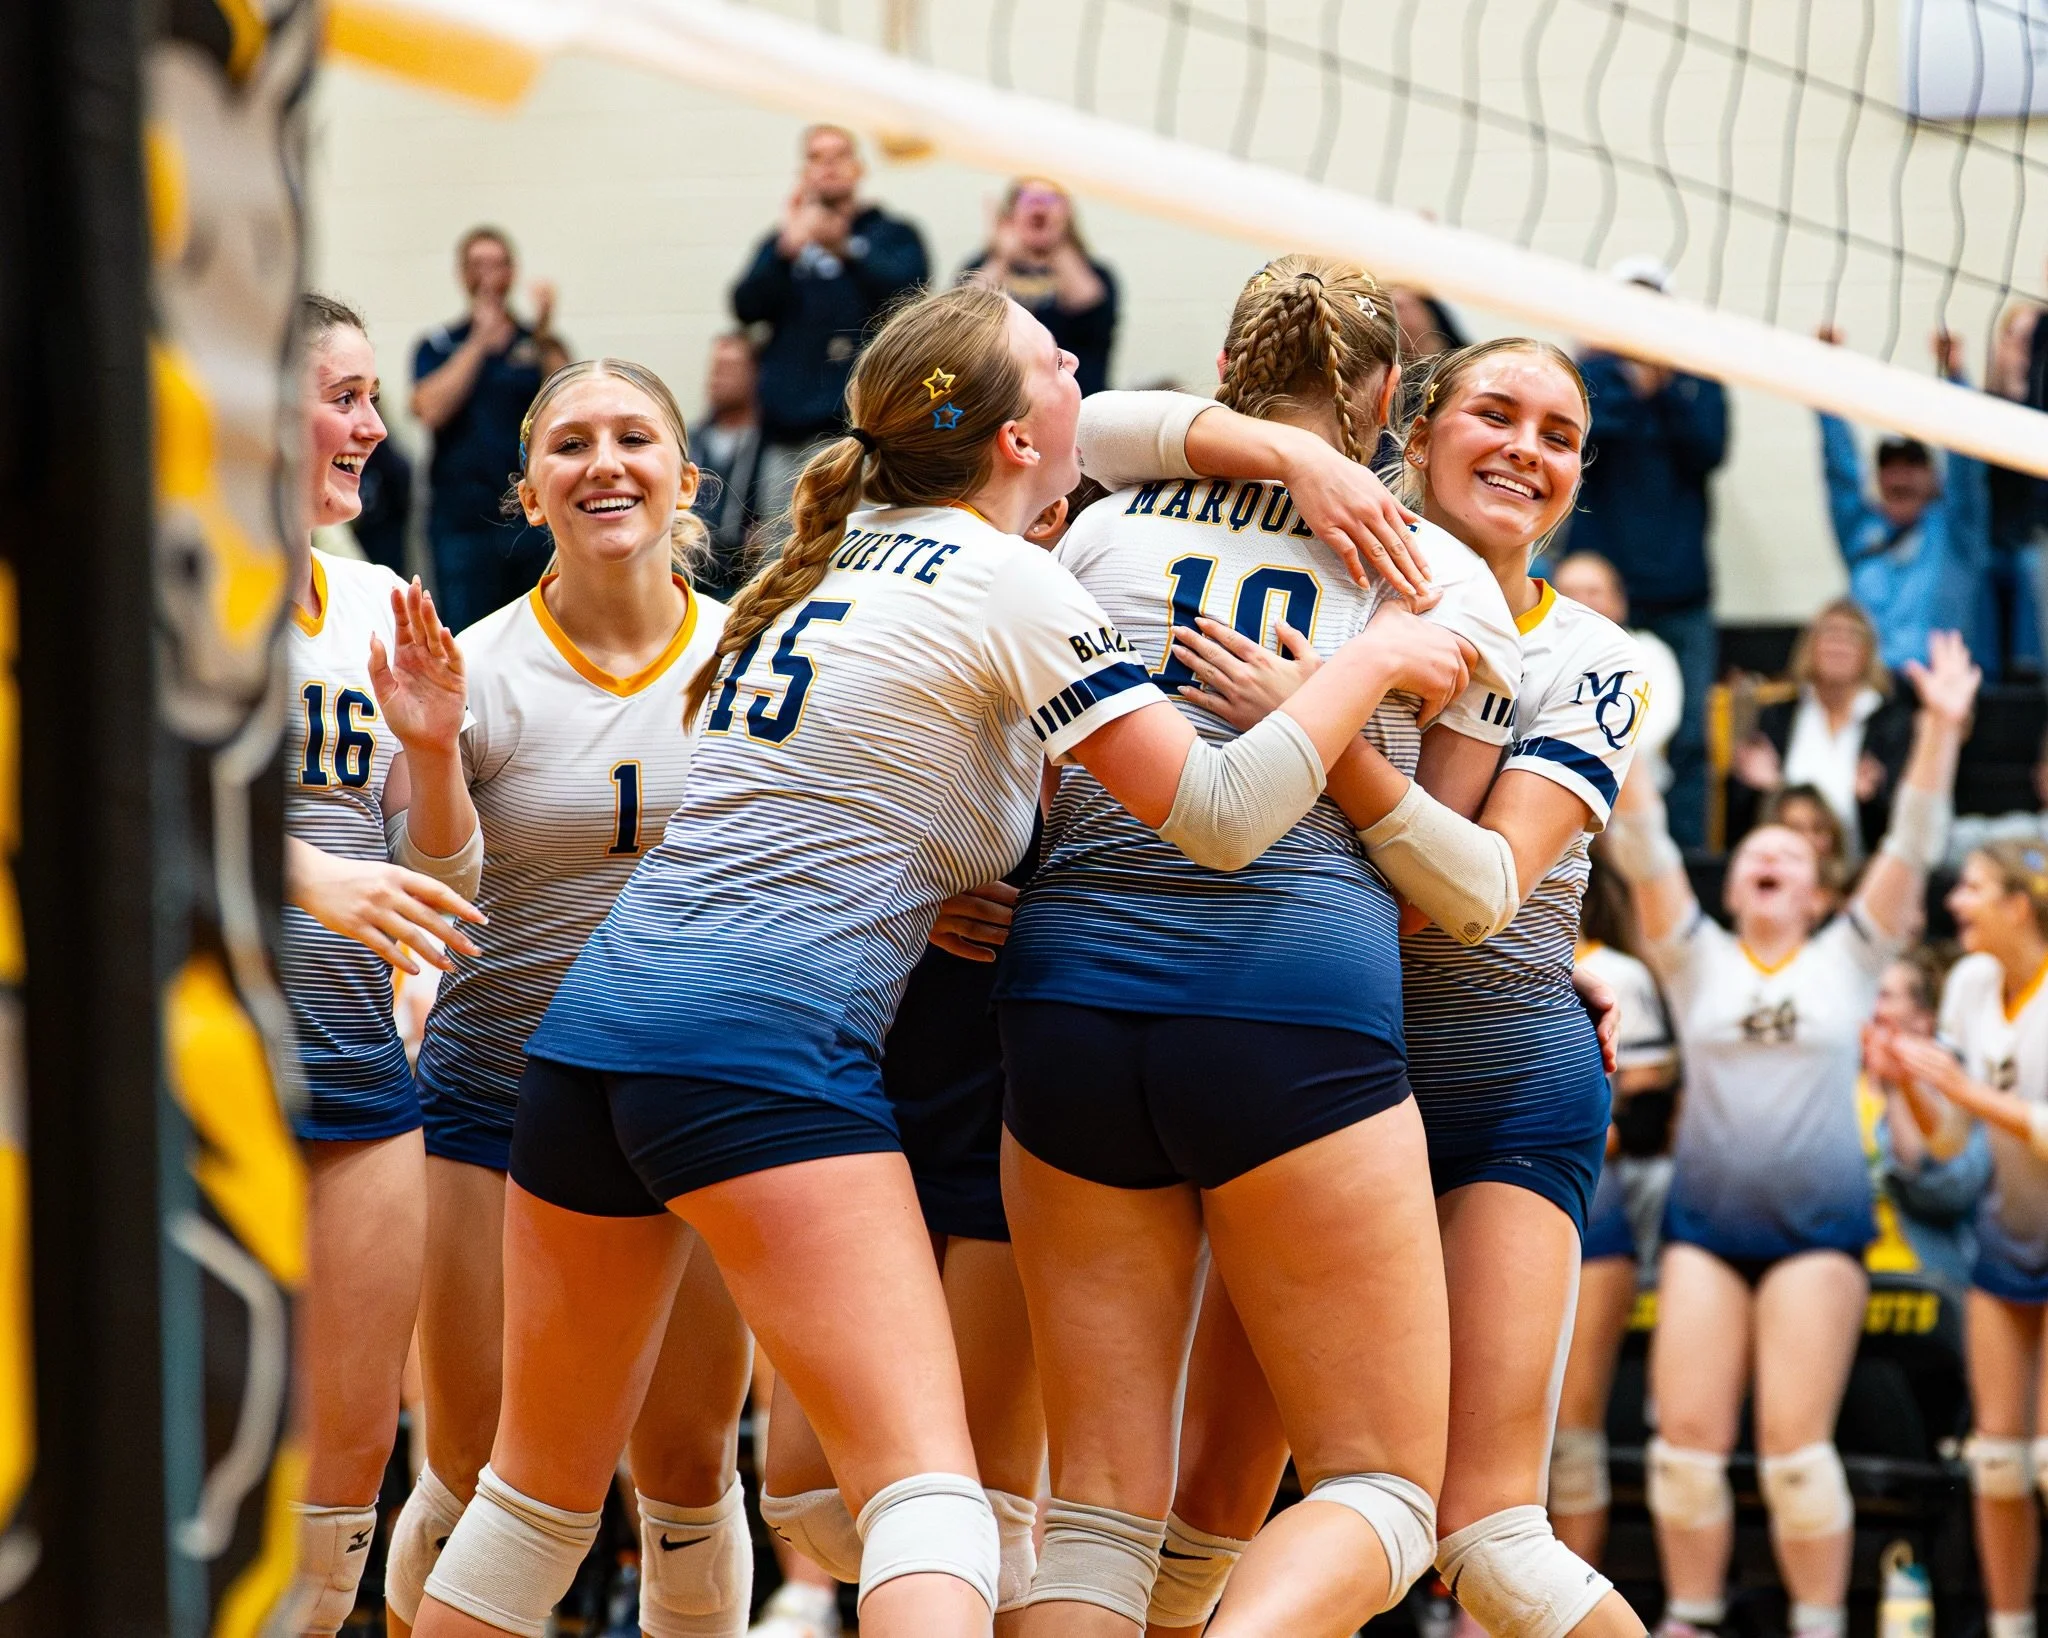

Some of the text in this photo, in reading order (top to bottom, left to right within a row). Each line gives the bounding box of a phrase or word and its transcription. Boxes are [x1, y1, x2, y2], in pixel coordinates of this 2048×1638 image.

[705, 597, 856, 748] 15
[1068, 627, 1138, 664] BLAZ
[1150, 553, 1324, 699] 10
[298, 680, 378, 790] 16
[605, 759, 643, 858] 1
